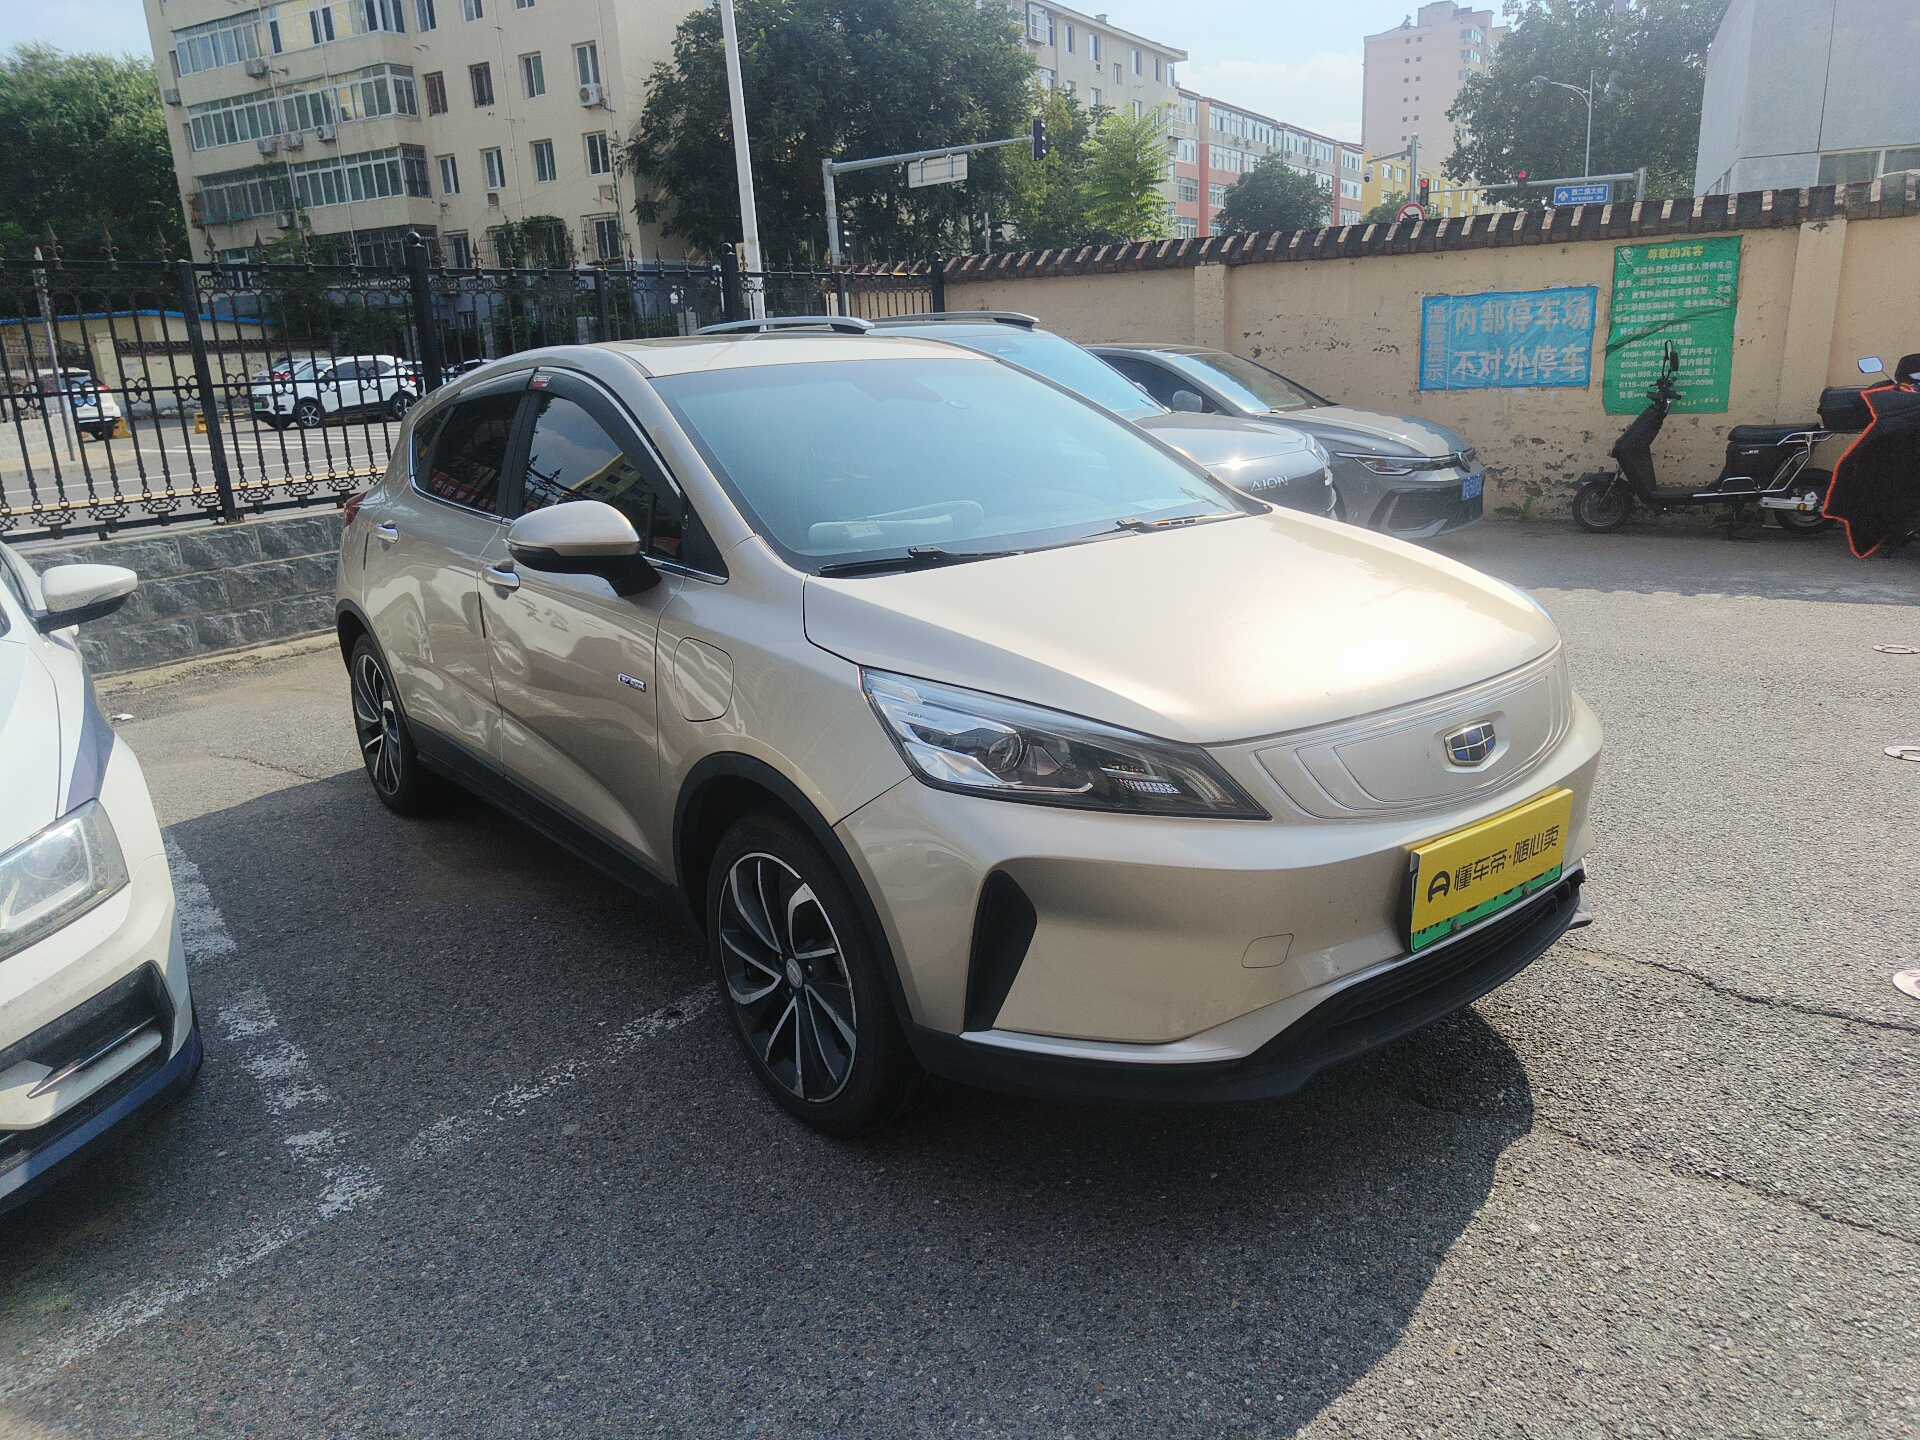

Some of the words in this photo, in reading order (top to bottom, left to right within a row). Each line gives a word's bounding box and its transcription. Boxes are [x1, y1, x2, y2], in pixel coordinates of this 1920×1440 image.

[1455, 294, 1590, 336] 内部停车场
[1451, 344, 1586, 381] 不对外停车
[1250, 475, 1289, 491] AION
